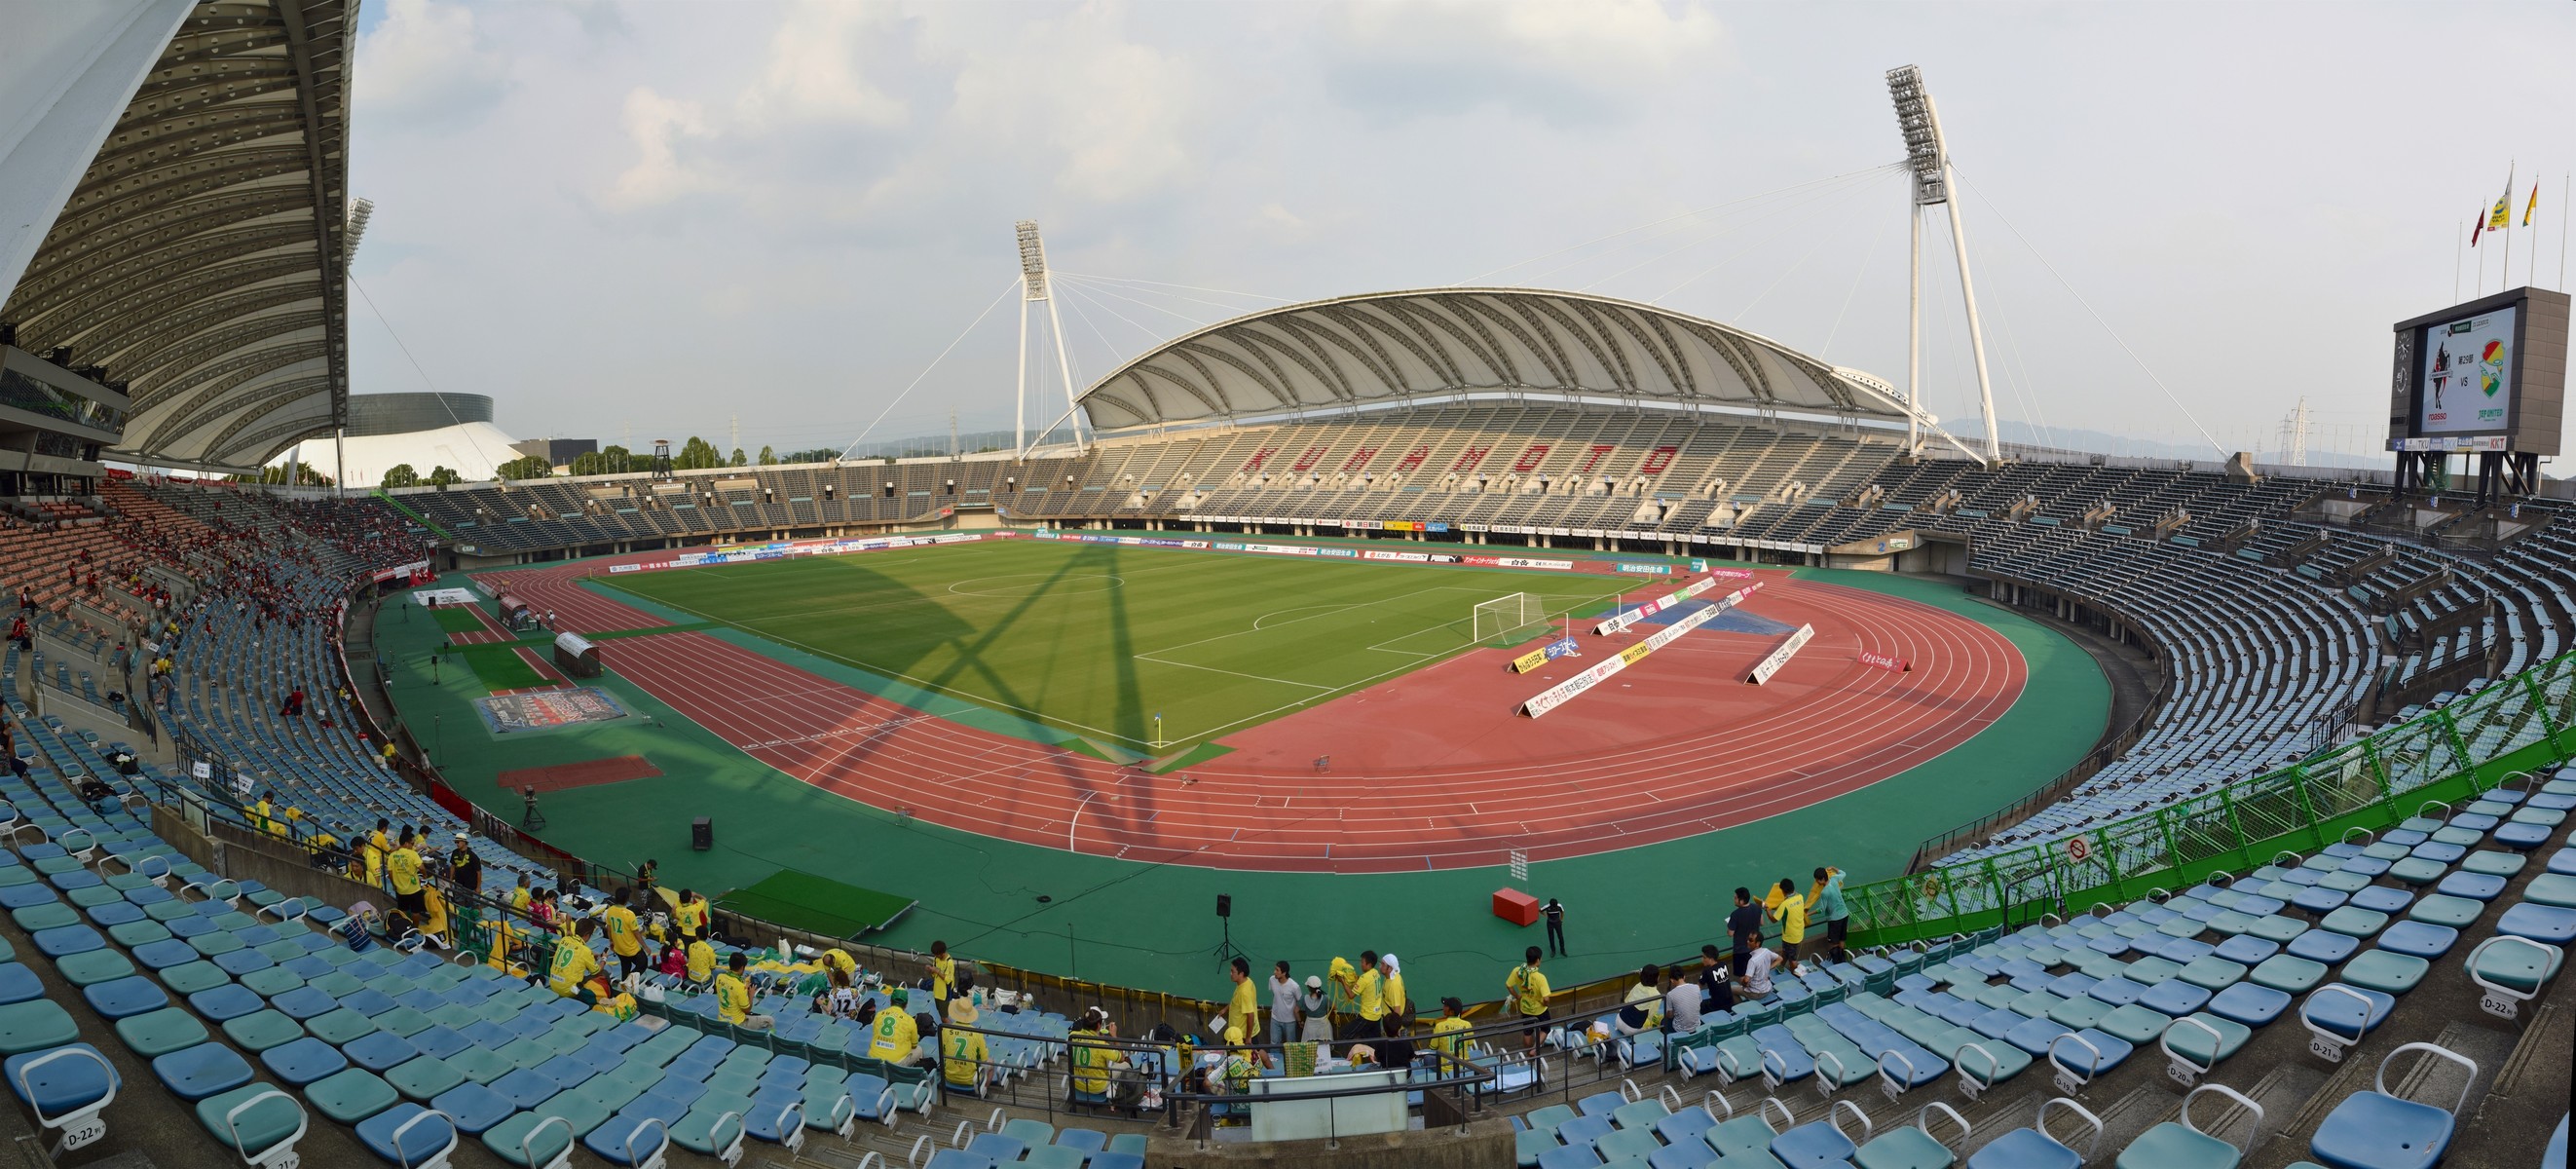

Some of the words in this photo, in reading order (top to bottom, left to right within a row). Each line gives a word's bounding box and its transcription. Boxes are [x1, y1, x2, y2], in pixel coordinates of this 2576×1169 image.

[2460, 376, 2469, 387] VS
[2428, 412, 2447, 421] roasso
[2486, 409, 2503, 418] UNITED
[2417, 439, 2429, 449] TKU
[2490, 437, 2505, 449] KKT
[1243, 445, 1678, 473] KUMAMOTO
[1878, 542, 1885, 552] 2
[1622, 564, 1663, 573] 明治安田生命
[1862, 652, 1893, 667] くまもとの赤
[610, 916, 623, 933] 12
[684, 914, 692, 925] 4
[554, 946, 574, 967] 19
[1712, 965, 1729, 981] MM
[721, 988, 730, 1008] 3
[837, 999, 851, 1013] 12
[880, 1016, 896, 1037] 8
[954, 1037, 967, 1059] 2
